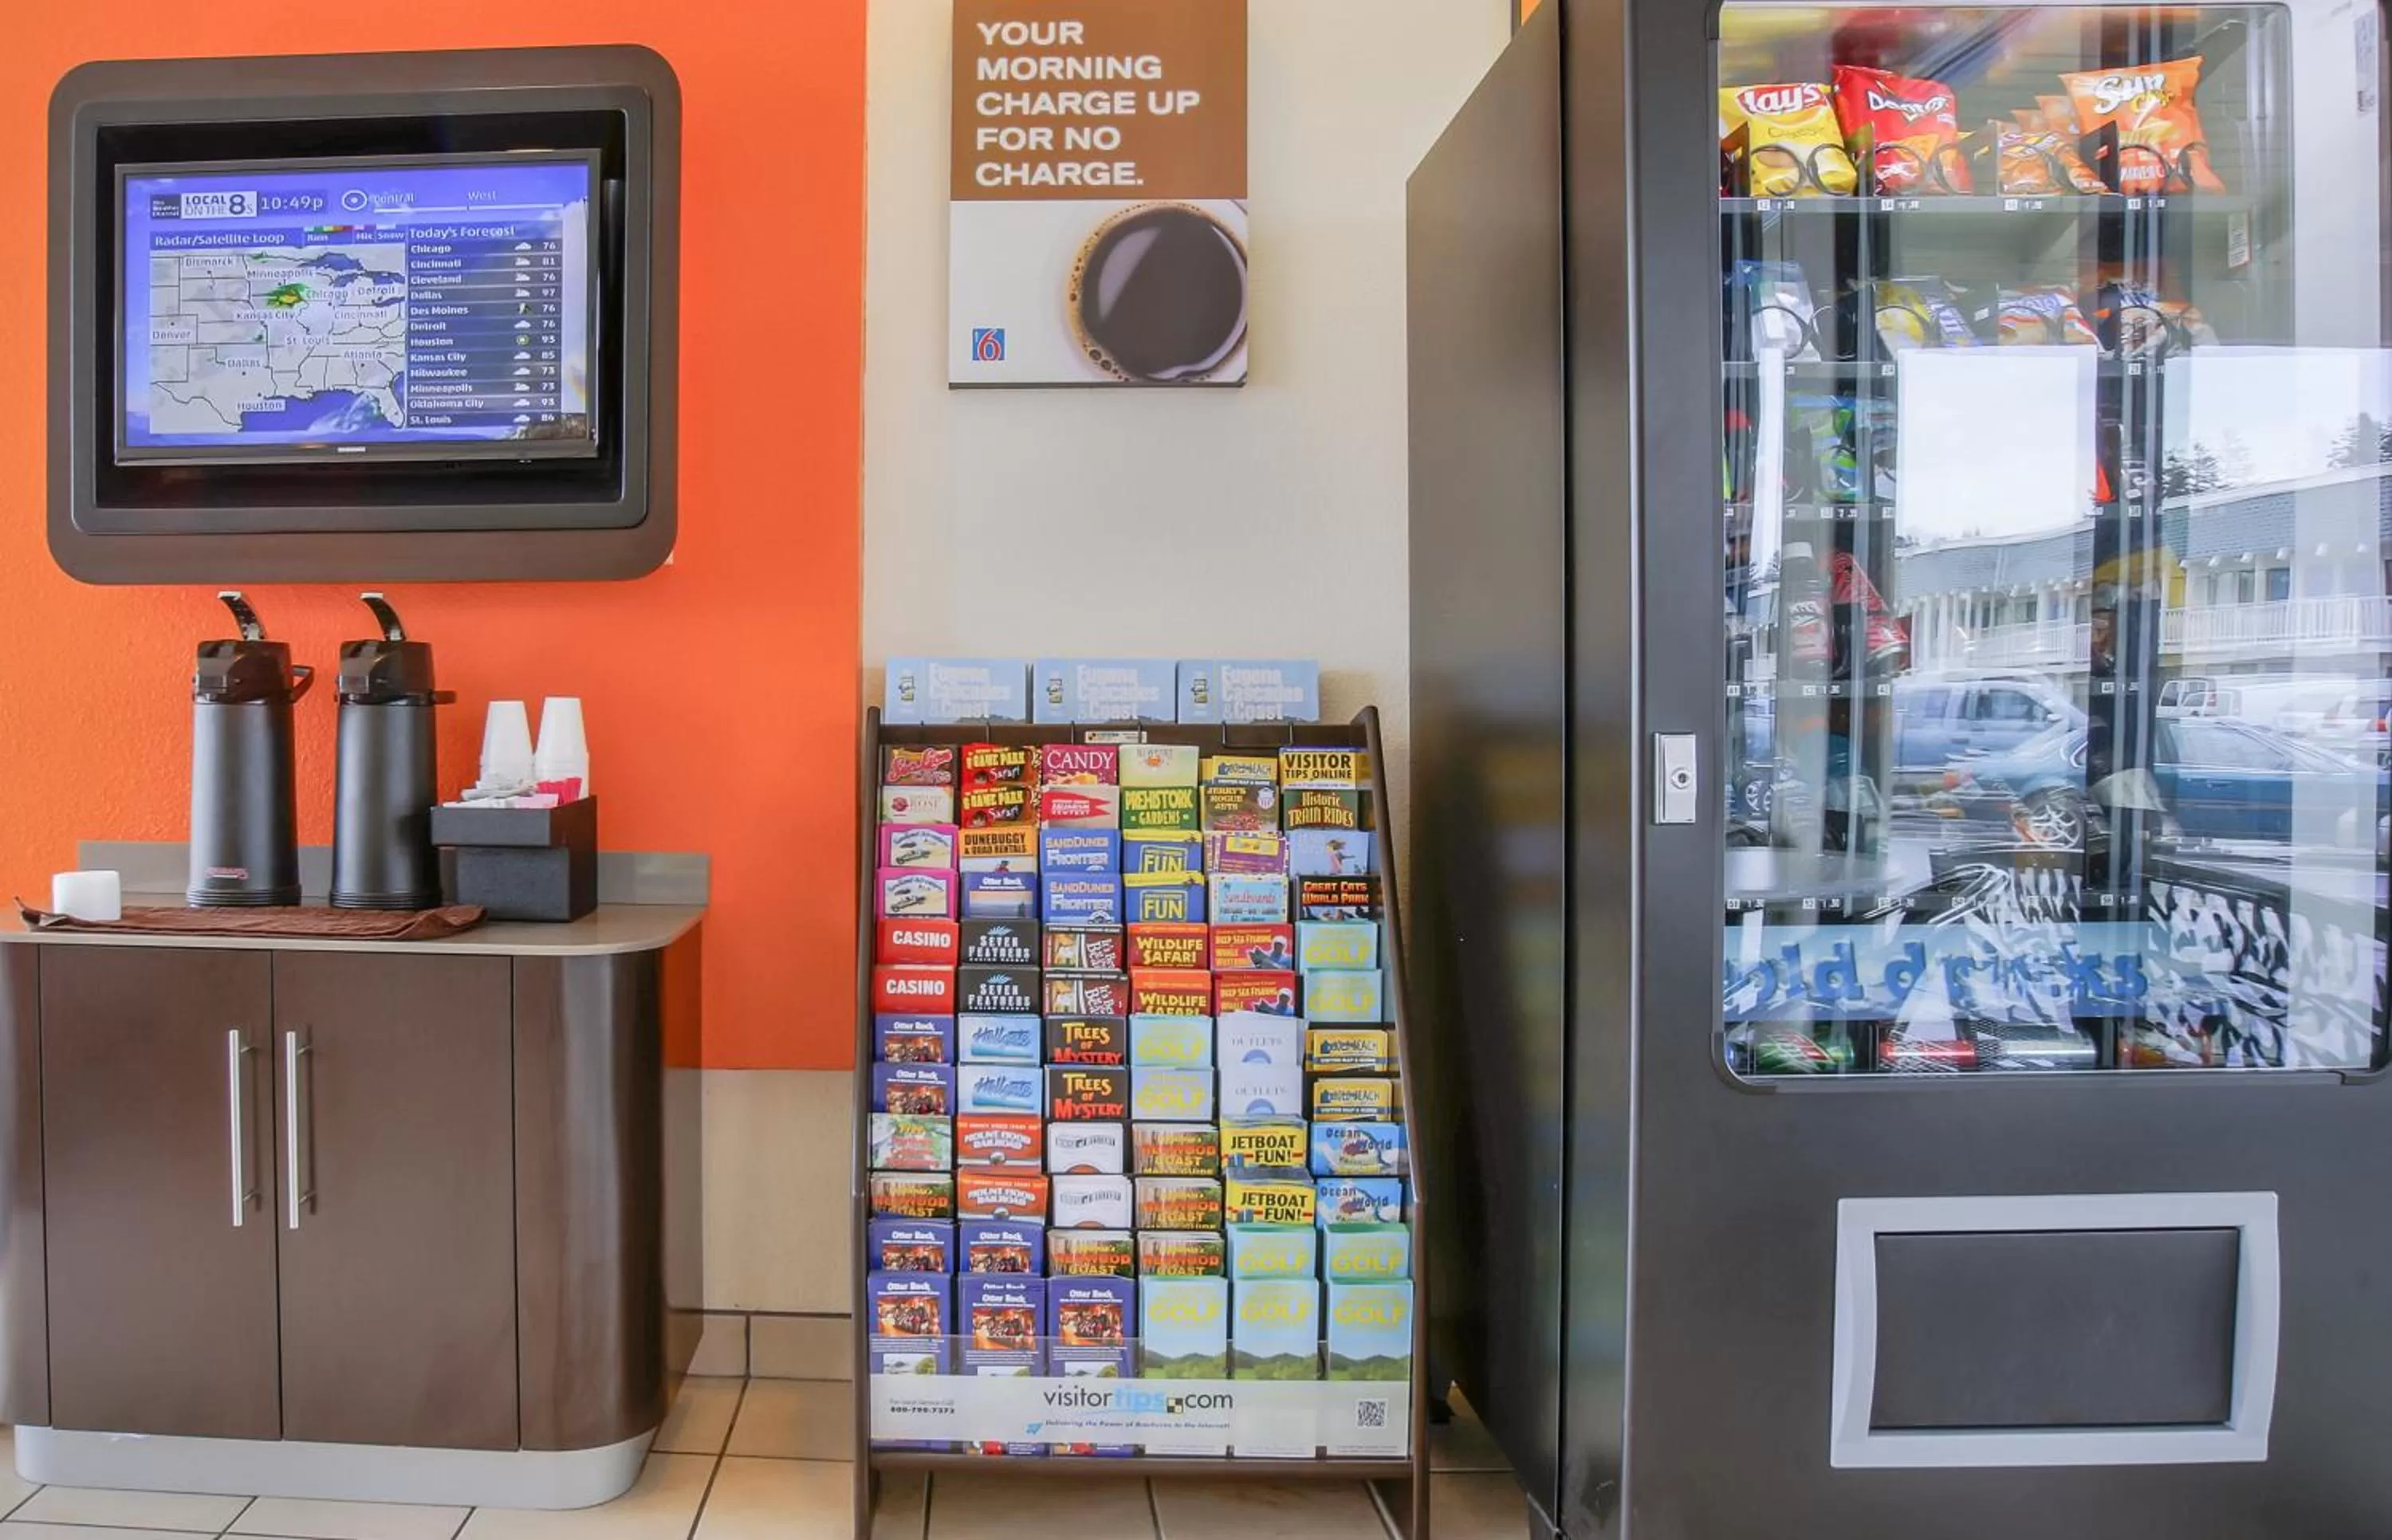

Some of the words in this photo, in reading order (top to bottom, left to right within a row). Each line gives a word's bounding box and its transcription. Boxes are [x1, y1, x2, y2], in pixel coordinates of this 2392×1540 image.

[977, 21, 1085, 46] YOUR
[976, 55, 1162, 81] MORNING
[1744, 83, 1820, 114] Lay's
[2093, 73, 2166, 115] Sun
[975, 91, 1136, 116] CHARGE
[1147, 89, 1200, 115] UP
[976, 127, 1053, 151] FOR
[1064, 126, 1122, 151] NO
[975, 162, 1144, 187] CHARGE.
[185, 194, 226, 205] LOCAL
[467, 191, 497, 201] West
[262, 195, 323, 210] 10:49p
[378, 230, 405, 240] Snow
[409, 226, 457, 239] Today's
[459, 225, 516, 238] Forecast
[155, 233, 250, 246] Radar/Satellite
[252, 233, 285, 245] Loop
[410, 244, 452, 254] Chicago
[542, 242, 557, 250] 76
[185, 257, 234, 266] Bismarck
[410, 259, 462, 269] Cincinnati
[246, 269, 313, 279] Minneapolis
[410, 274, 462, 285] Cleveland
[542, 273, 557, 281] 76
[306, 289, 349, 301] Chicago
[357, 285, 395, 296] Detroit
[410, 291, 443, 301] Dallas
[237, 311, 273, 320] Kansas
[275, 311, 296, 320] City
[334, 309, 388, 319] Cincinnati
[410, 306, 430, 315] Des
[431, 306, 470, 316] Moines
[542, 304, 556, 312] 76
[410, 321, 447, 331] Detroit
[542, 320, 556, 328] 76
[151, 330, 191, 340] Denver
[286, 336, 299, 345] St.
[301, 336, 331, 345] Louis
[410, 336, 454, 346] Houston
[977, 328, 1002, 361] 6
[344, 350, 383, 359] Atlanta
[410, 352, 446, 362] Kansas
[447, 352, 467, 363] City
[226, 359, 262, 368] Dallas
[410, 367, 468, 377] Milwaukee
[410, 383, 473, 394] Minneapolis
[237, 401, 283, 411] Houston
[410, 399, 463, 409] Oklahoma
[464, 399, 485, 409] City
[410, 415, 424, 425] St.
[424, 414, 453, 425] Louis
[1047, 750, 1115, 770] CANDY
[1284, 752, 1352, 769] VISITOR
[1285, 768, 1308, 780] TIPS
[1312, 768, 1352, 780] ONLINE
[1301, 791, 1341, 807] Historic
[1139, 810, 1181, 826] GARDENS
[1288, 807, 1322, 827] TRAIN
[1324, 806, 1354, 827] RIDES
[964, 832, 1027, 847] DUNEBUGGY
[994, 845, 1027, 854] RENTALS
[1144, 853, 1183, 873] FUN
[1302, 881, 1339, 893] GREAT
[1340, 880, 1368, 892] CATS
[1302, 893, 1340, 905] WORLD
[1340, 893, 1370, 905] PARK
[1144, 899, 1183, 919] FUN
[892, 930, 951, 949] CASINO
[980, 936, 1019, 948] SEVEN
[1136, 936, 1203, 950] WILDLIFE
[1215, 935, 1232, 944] DEEP
[1233, 935, 1245, 944] SEA
[1246, 934, 1273, 943] FISHING
[1143, 949, 1196, 964] SAFARI
[886, 979, 946, 996] CASINO
[1139, 992, 1206, 1006] WILDLIFE
[1146, 1005, 1199, 1016] SAFARI
[893, 1021, 914, 1031] Otter
[915, 1021, 936, 1031] Rock
[1062, 1022, 1111, 1045] TREES
[1080, 1041, 1093, 1051] OF
[1053, 1047, 1123, 1064] MYSTERY
[1062, 1073, 1111, 1096] TREES
[1081, 1091, 1094, 1102] OF
[1054, 1098, 1123, 1120] MYSTERY
[1326, 1127, 1362, 1139] Ocean
[1230, 1135, 1296, 1149] JETBOAT
[1358, 1138, 1392, 1151] World
[1154, 1156, 1204, 1167] COAST
[1254, 1149, 1292, 1164] FUN!
[1320, 1184, 1357, 1197] Ocean
[1241, 1193, 1308, 1208] JETBOAT
[1354, 1195, 1390, 1208] World
[1264, 1208, 1303, 1222] FUN!
[1068, 1265, 1116, 1275] COAST
[982, 1294, 1004, 1303] Otter
[1005, 1294, 1026, 1303] Rock
[1069, 1289, 1091, 1298] Otter
[1092, 1289, 1114, 1299] Rock
